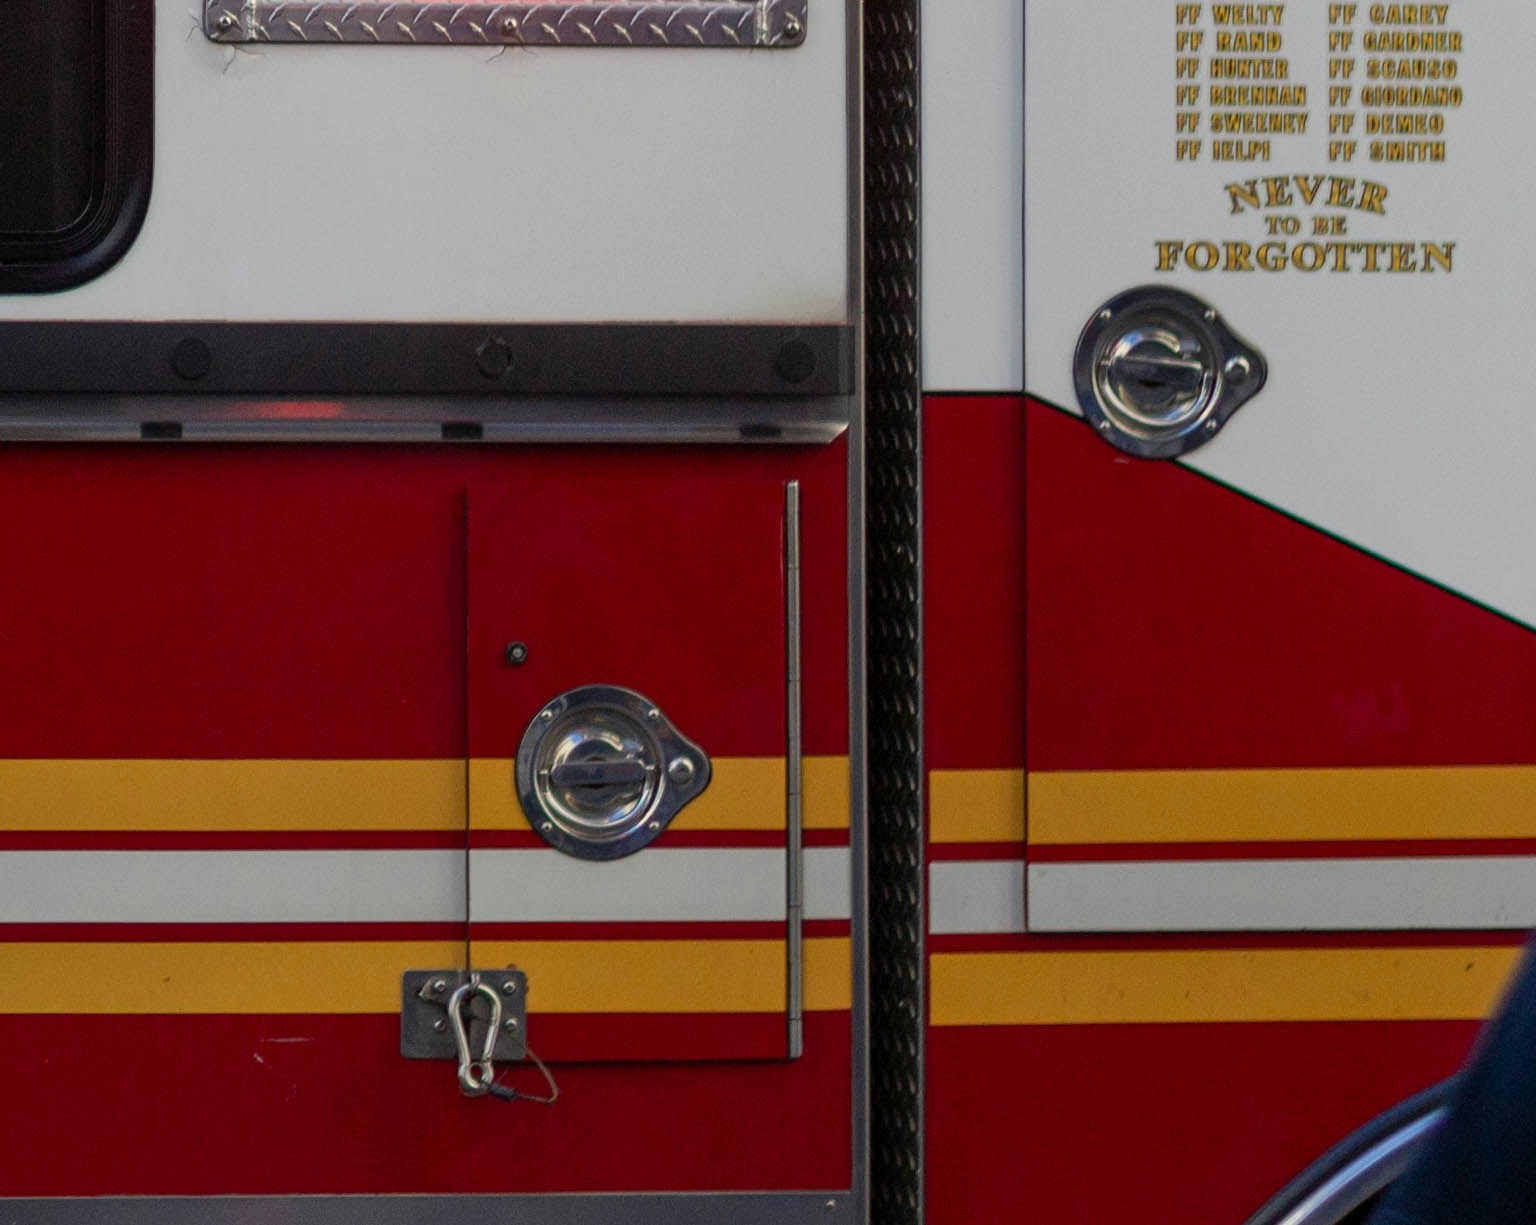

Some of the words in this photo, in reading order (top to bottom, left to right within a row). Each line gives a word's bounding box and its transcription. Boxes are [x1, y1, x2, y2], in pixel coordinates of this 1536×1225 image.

[1177, 4, 1200, 24] FF
[1212, 5, 1283, 24] WELTY
[1329, 4, 1355, 24] FF
[1370, 4, 1448, 24] CAREY
[1177, 31, 1202, 50] FF
[1217, 31, 1281, 51] RAND
[1329, 32, 1352, 50] FF
[1364, 32, 1462, 52] GARDNER
[1176, 58, 1198, 77] FF
[1210, 59, 1288, 78] HUNTER
[1329, 59, 1354, 78] FF
[1177, 85, 1199, 104] FF
[1210, 85, 1306, 105] BRENNAN
[1329, 87, 1351, 105] FF
[1177, 113, 1199, 131] FF
[1211, 112, 1307, 133] SWEENEY
[1330, 114, 1353, 132] FF
[1366, 114, 1444, 134] DEMEO
[1177, 140, 1200, 159] FF
[1330, 141, 1356, 160] FF
[1370, 141, 1445, 161] SMITH
[1225, 176, 1388, 215] NEVER
[1266, 216, 1300, 234] TO
[1314, 216, 1345, 234] BE
[1155, 241, 1456, 272] FORGOTTEN
